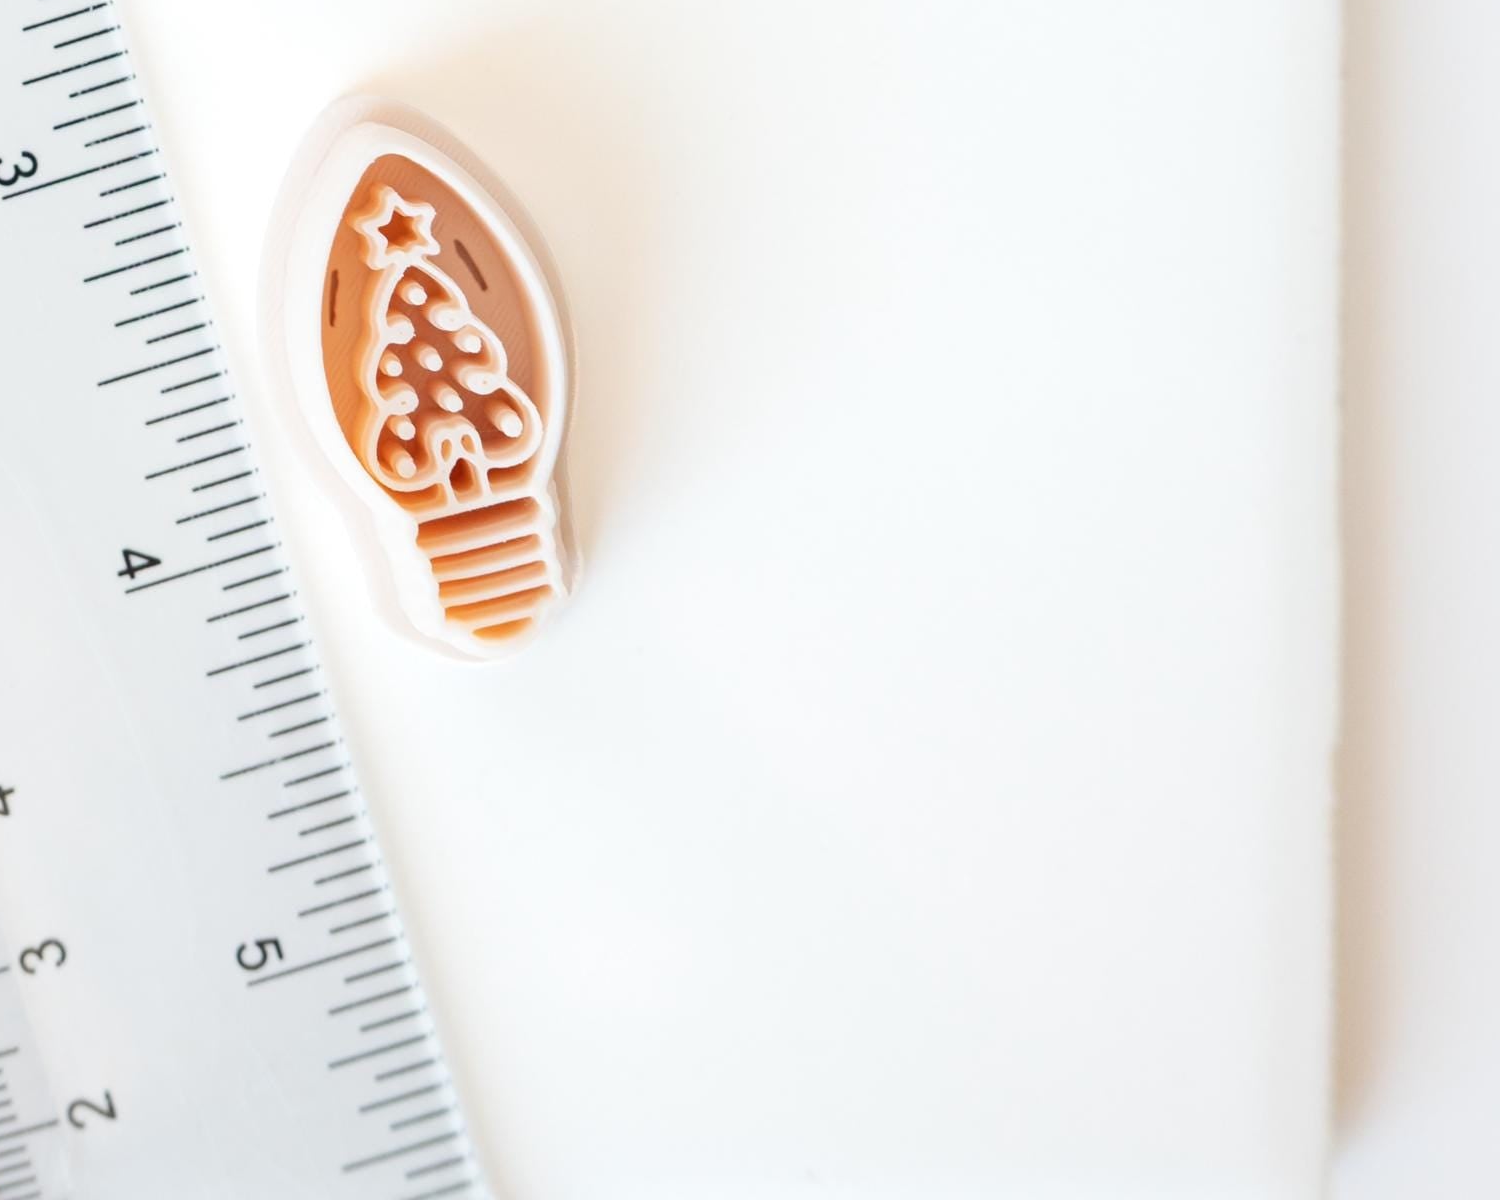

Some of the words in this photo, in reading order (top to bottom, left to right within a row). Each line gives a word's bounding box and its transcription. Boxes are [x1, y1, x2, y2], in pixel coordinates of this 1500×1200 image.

[117, 548, 162, 580] 4
[18, 938, 67, 975] 3
[236, 937, 284, 972] 5
[66, 1091, 117, 1130] 2
